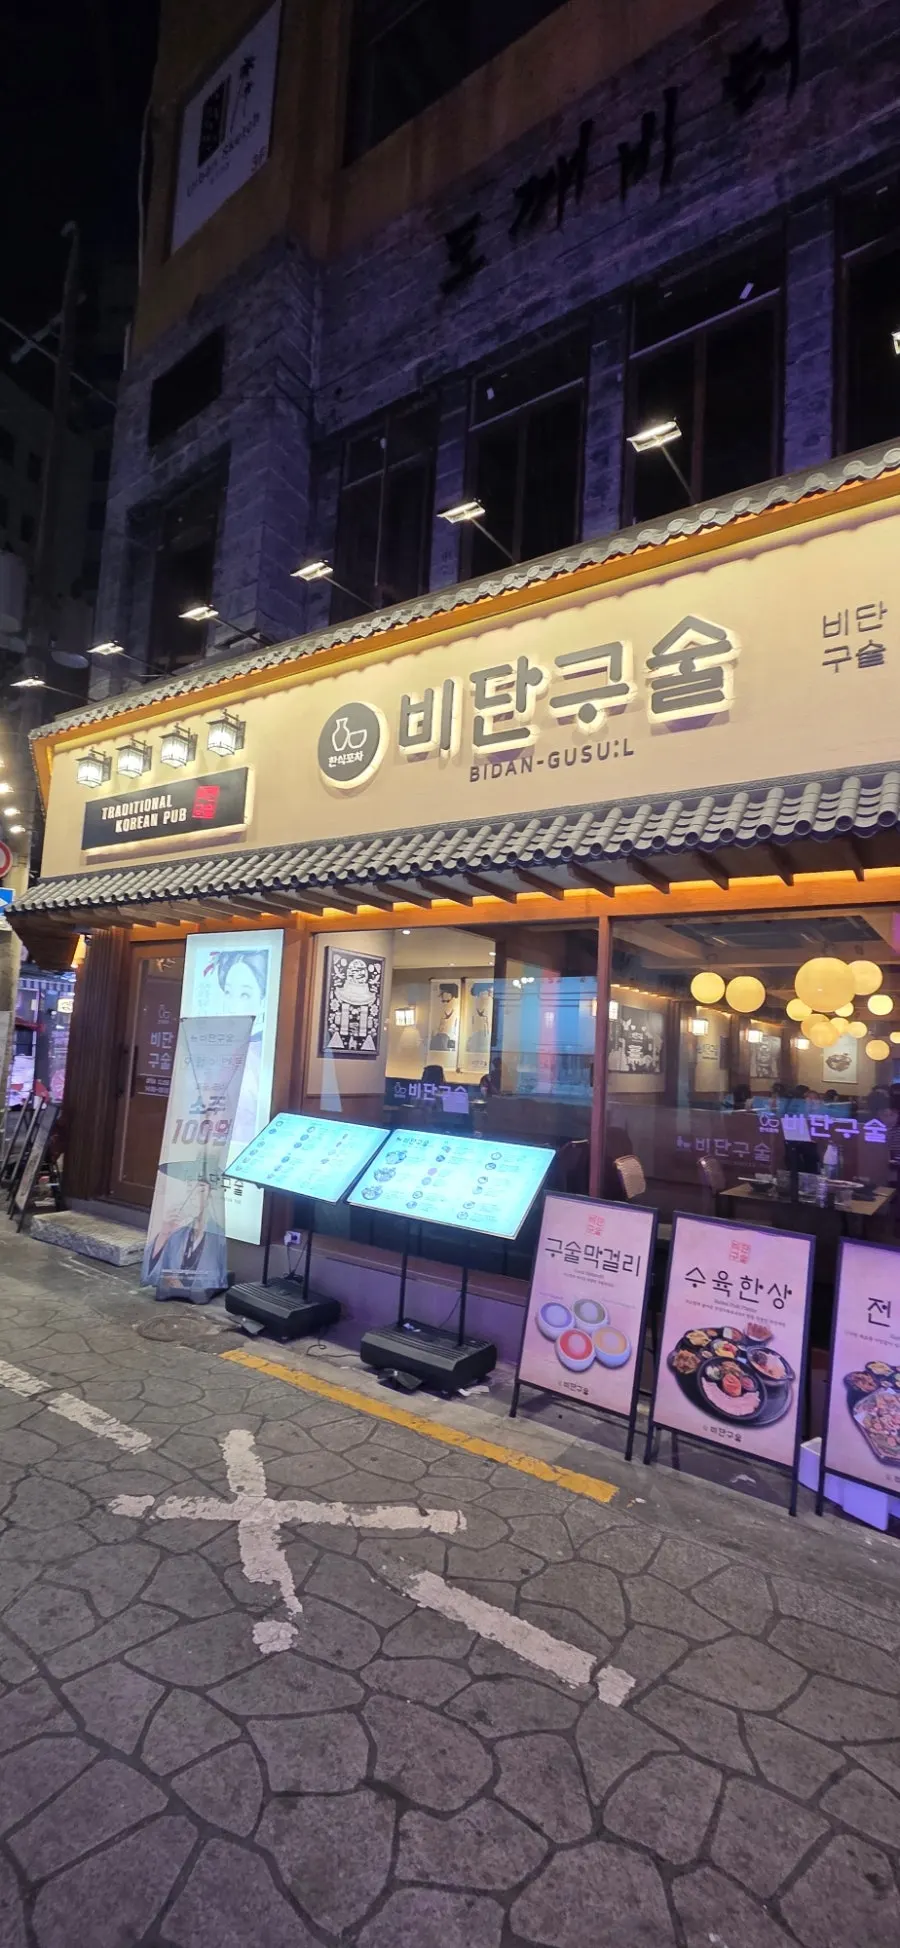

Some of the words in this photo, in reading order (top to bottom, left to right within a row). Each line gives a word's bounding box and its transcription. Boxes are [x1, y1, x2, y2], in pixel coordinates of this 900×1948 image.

[822, 600, 888, 639] 비단
[822, 639, 887, 674] 구술
[399, 613, 735, 752] 비단구술
[327, 750, 365, 769] 한식포차
[101, 795, 173, 820] TRADITIONAL
[115, 812, 159, 834] KOREAN
[163, 807, 188, 825] PUB
[150, 1031, 175, 1049] 비단
[148, 1052, 172, 1070] 구술
[783, 1113, 888, 1143] 비단구술
[696, 1137, 771, 1162] 비단구술
[544, 1237, 642, 1277] 구술막걸리
[684, 1266, 793, 1310] 수육한상
